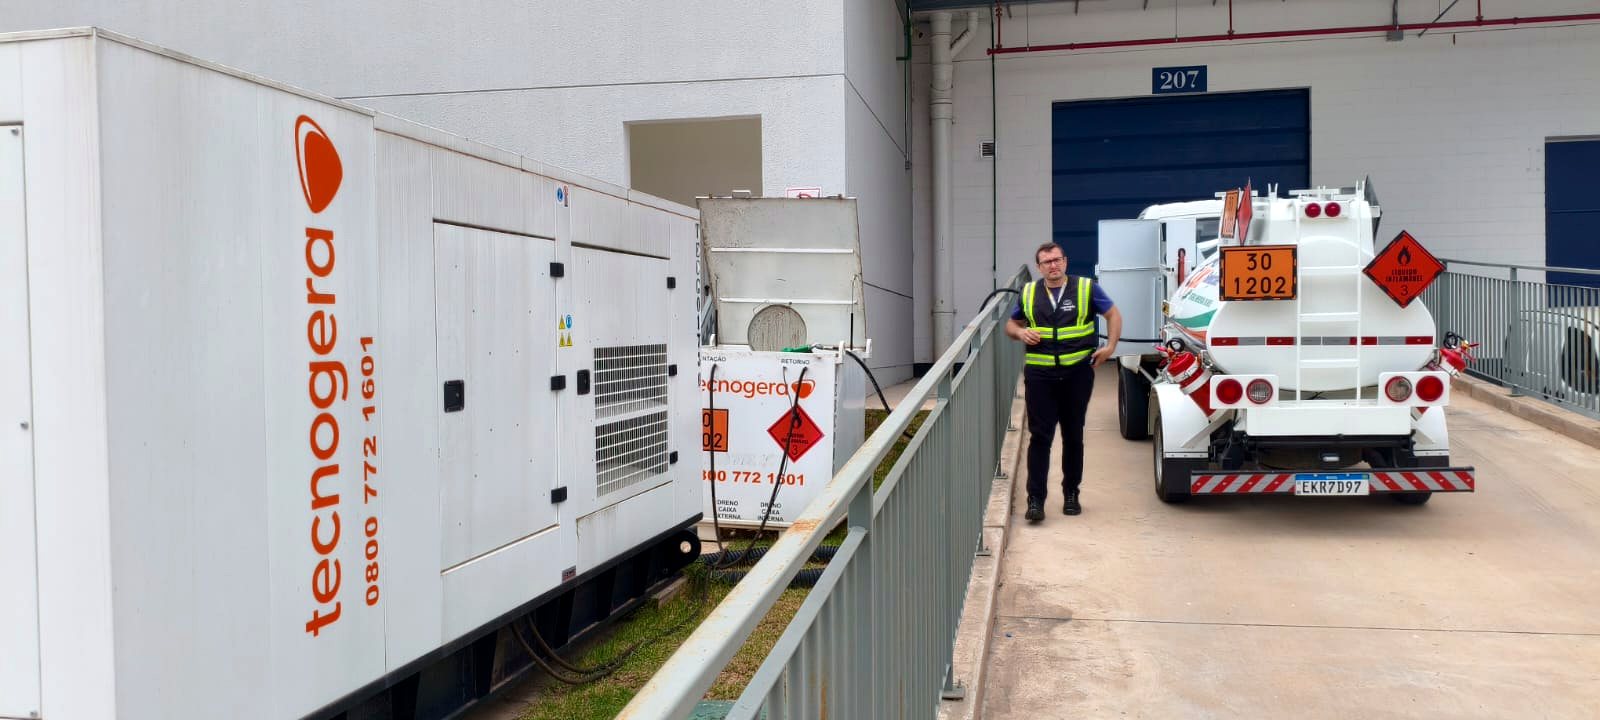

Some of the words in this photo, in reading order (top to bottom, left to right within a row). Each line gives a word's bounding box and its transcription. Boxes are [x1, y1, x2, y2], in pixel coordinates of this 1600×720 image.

[1160, 70, 1199, 89] 207
[1246, 253, 1272, 271] 30
[1234, 276, 1286, 295] 1202
[1400, 284, 1409, 297] 3
[360, 336, 376, 422] 1601
[305, 227, 349, 637] tecnogera
[791, 444, 799, 456] 3
[363, 435, 378, 504] 772
[732, 471, 761, 484] 772
[1302, 481, 1362, 494] EKR7D97
[760, 501, 782, 509] DRNO
[717, 512, 742, 520] XTERNA
[364, 515, 380, 606] 0800
